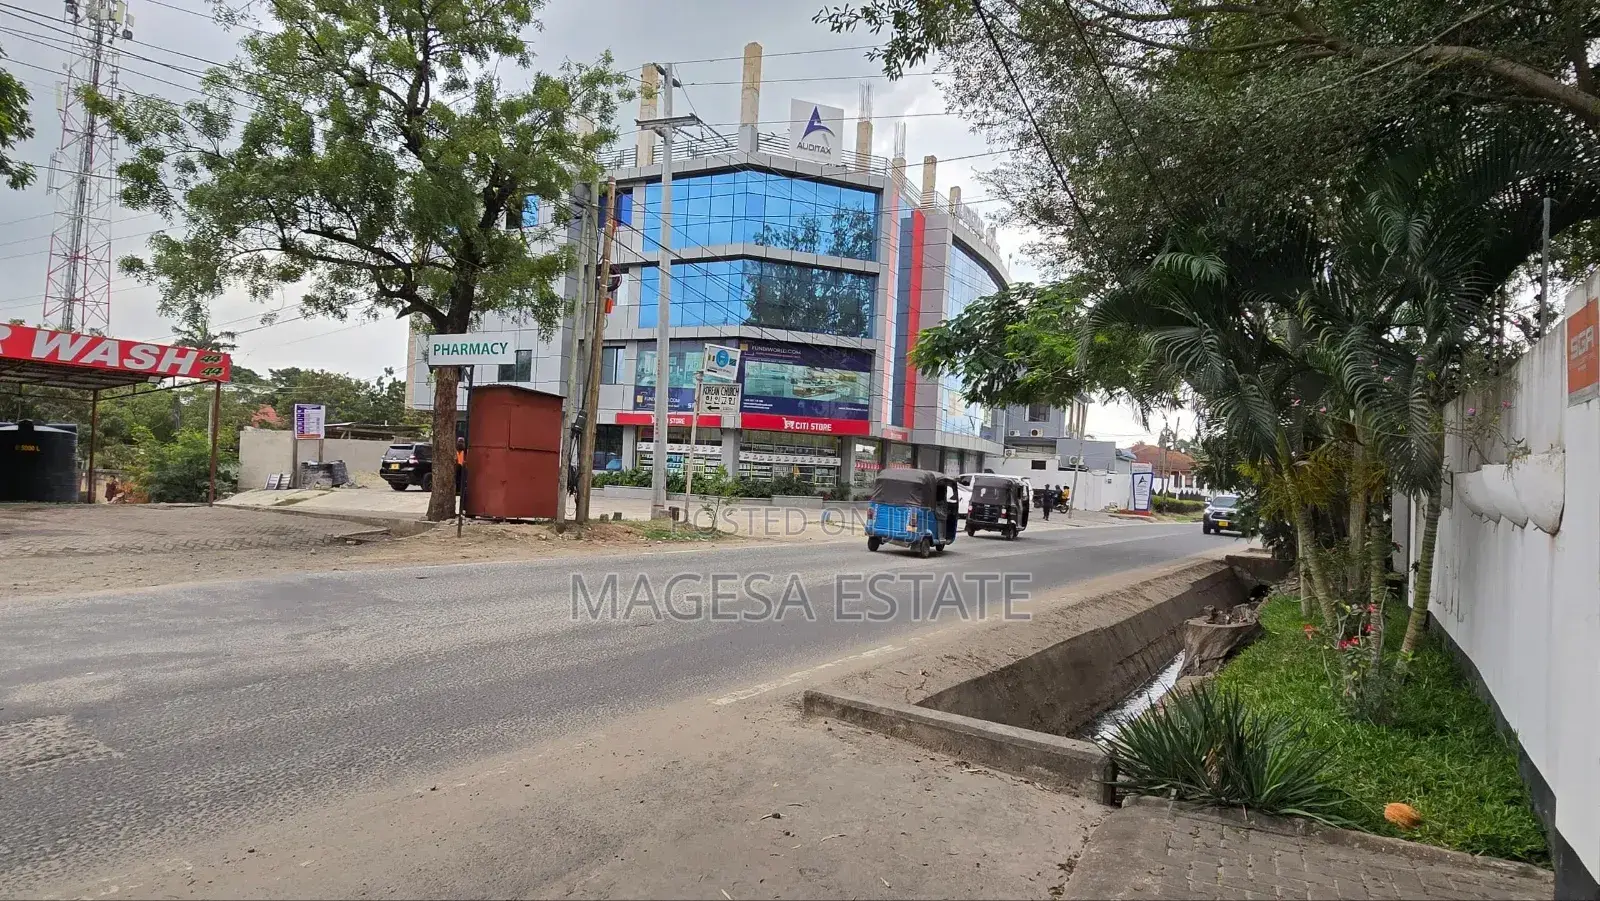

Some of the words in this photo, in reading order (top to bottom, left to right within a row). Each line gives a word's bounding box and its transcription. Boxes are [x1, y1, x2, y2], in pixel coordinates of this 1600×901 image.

[797, 141, 832, 155] AUDITAX
[31, 329, 199, 375] WASH
[433, 342, 508, 356] PHARMACY
[703, 386, 720, 396] KOREAN
[720, 386, 740, 397] CHURCH
[795, 421, 809, 430] CITI
[810, 422, 833, 432] STORE
